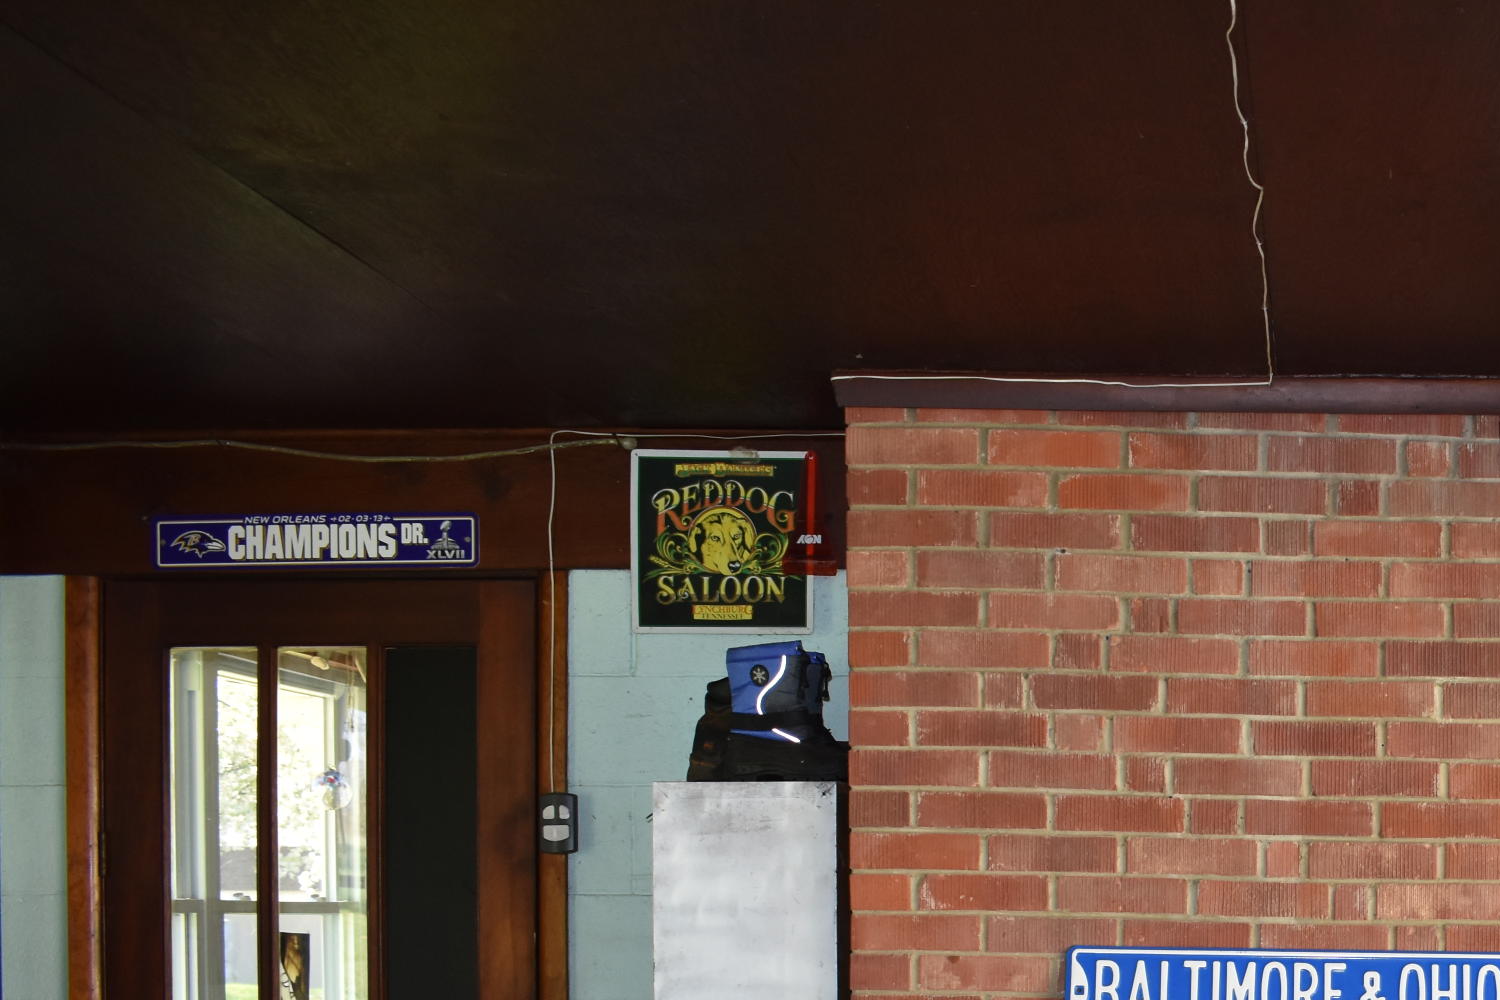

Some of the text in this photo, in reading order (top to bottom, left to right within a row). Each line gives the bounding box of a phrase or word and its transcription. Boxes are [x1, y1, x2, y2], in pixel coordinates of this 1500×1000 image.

[244, 516, 270, 524] NEW
[271, 515, 327, 524] ORLEANS
[227, 522, 429, 561] CHAMPIONS DR.
[426, 549, 466, 560] XLVII
[656, 575, 789, 605] SALOON
[692, 605, 754, 614] LYNCHBURG
